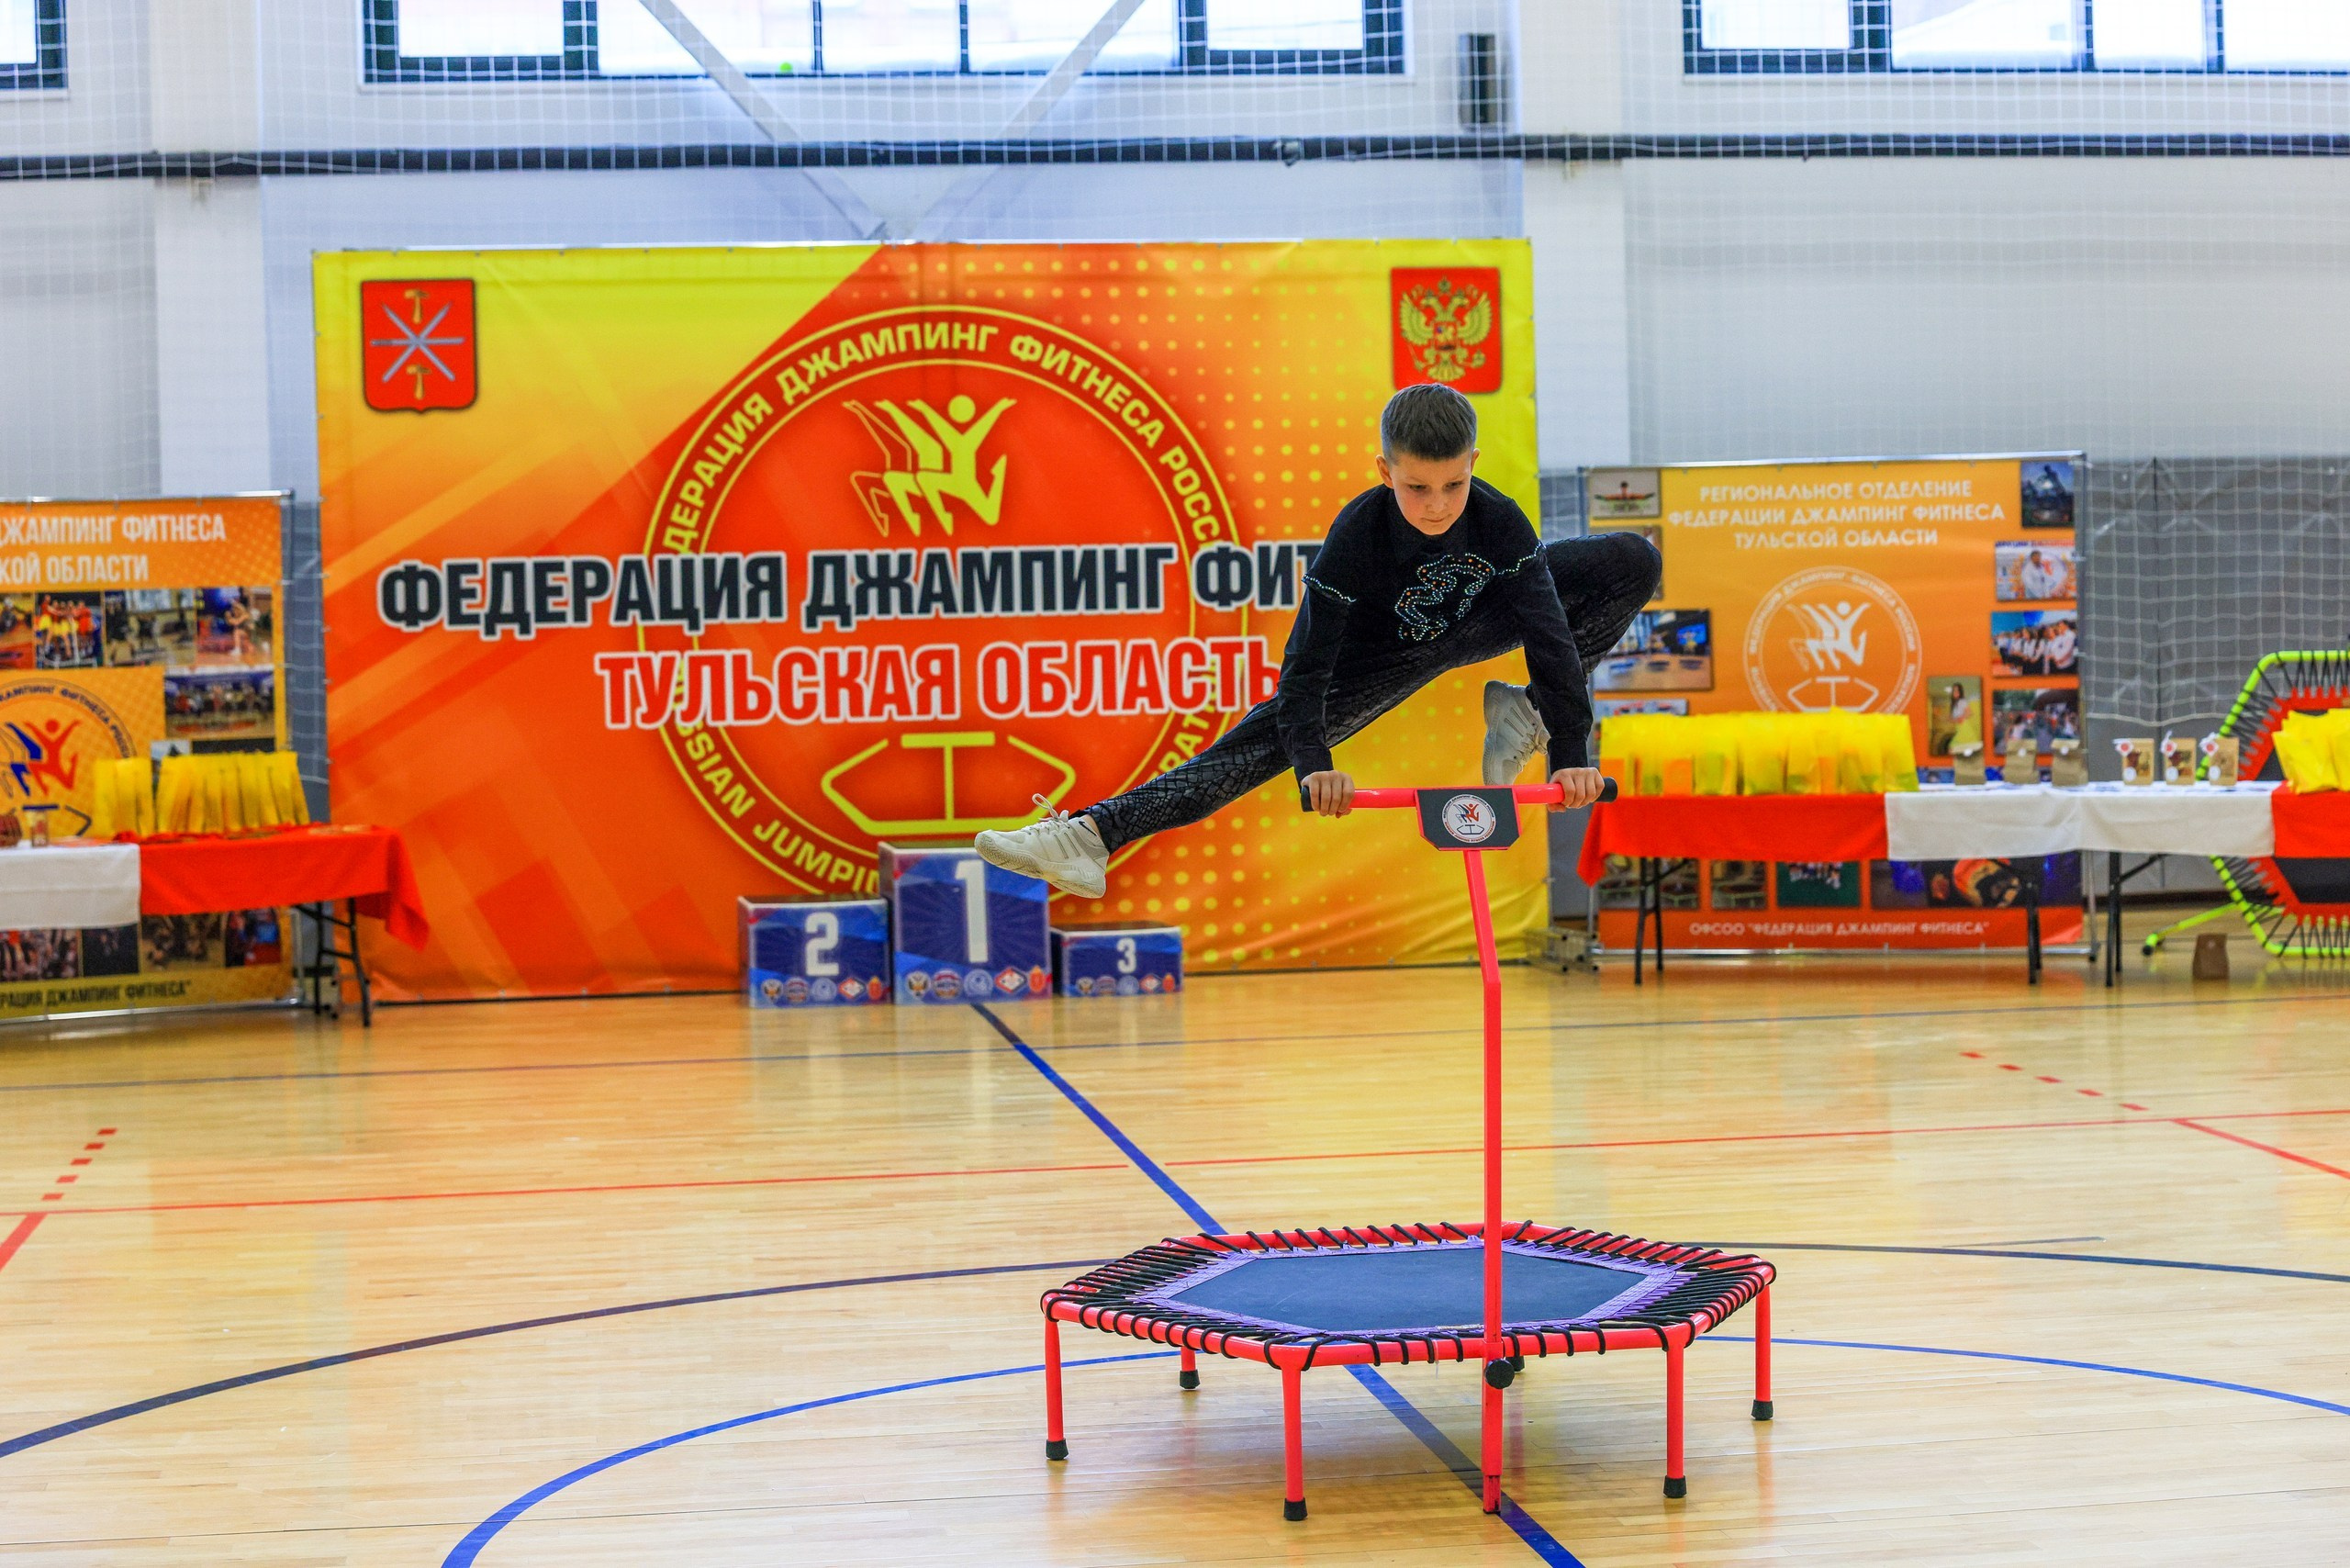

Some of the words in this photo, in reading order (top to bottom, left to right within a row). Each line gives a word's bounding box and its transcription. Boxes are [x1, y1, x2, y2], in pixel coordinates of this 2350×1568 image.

[776, 323, 999, 406] ДЖАМПИНГ
[1010, 334, 1165, 449] ФИТНЕСА
[1158, 444, 1221, 549] РОСС
[1699, 482, 1852, 502] РЕГИОНАЛЬНОЕ
[1859, 479, 1972, 499] ОТДЕЛЕНИЕ
[0, 514, 117, 547] ЖАМПИНГ
[122, 512, 227, 543] ФИТНЕСА
[1668, 510, 1785, 527] ФЕДЕРАЦИИ
[1790, 506, 1908, 526] ДЖАМПИНГ
[1912, 502, 2005, 521] ФИТНЕСА
[1734, 527, 1837, 550] ТУЛЬСКОЙ
[1843, 528, 1938, 547] ОБЛАСТИ
[47, 554, 150, 584] ОБЛАСТИ
[378, 551, 787, 641] ФЕДЕРАЦИЯ
[801, 542, 1177, 633] ДЖАМПИНГ
[595, 644, 960, 730] ТУЛЬСКАЯ
[977, 636, 1281, 719] ОБЛАСТЬ
[955, 859, 989, 963] 1
[805, 912, 839, 976] 2
[1116, 938, 1136, 973] 3
